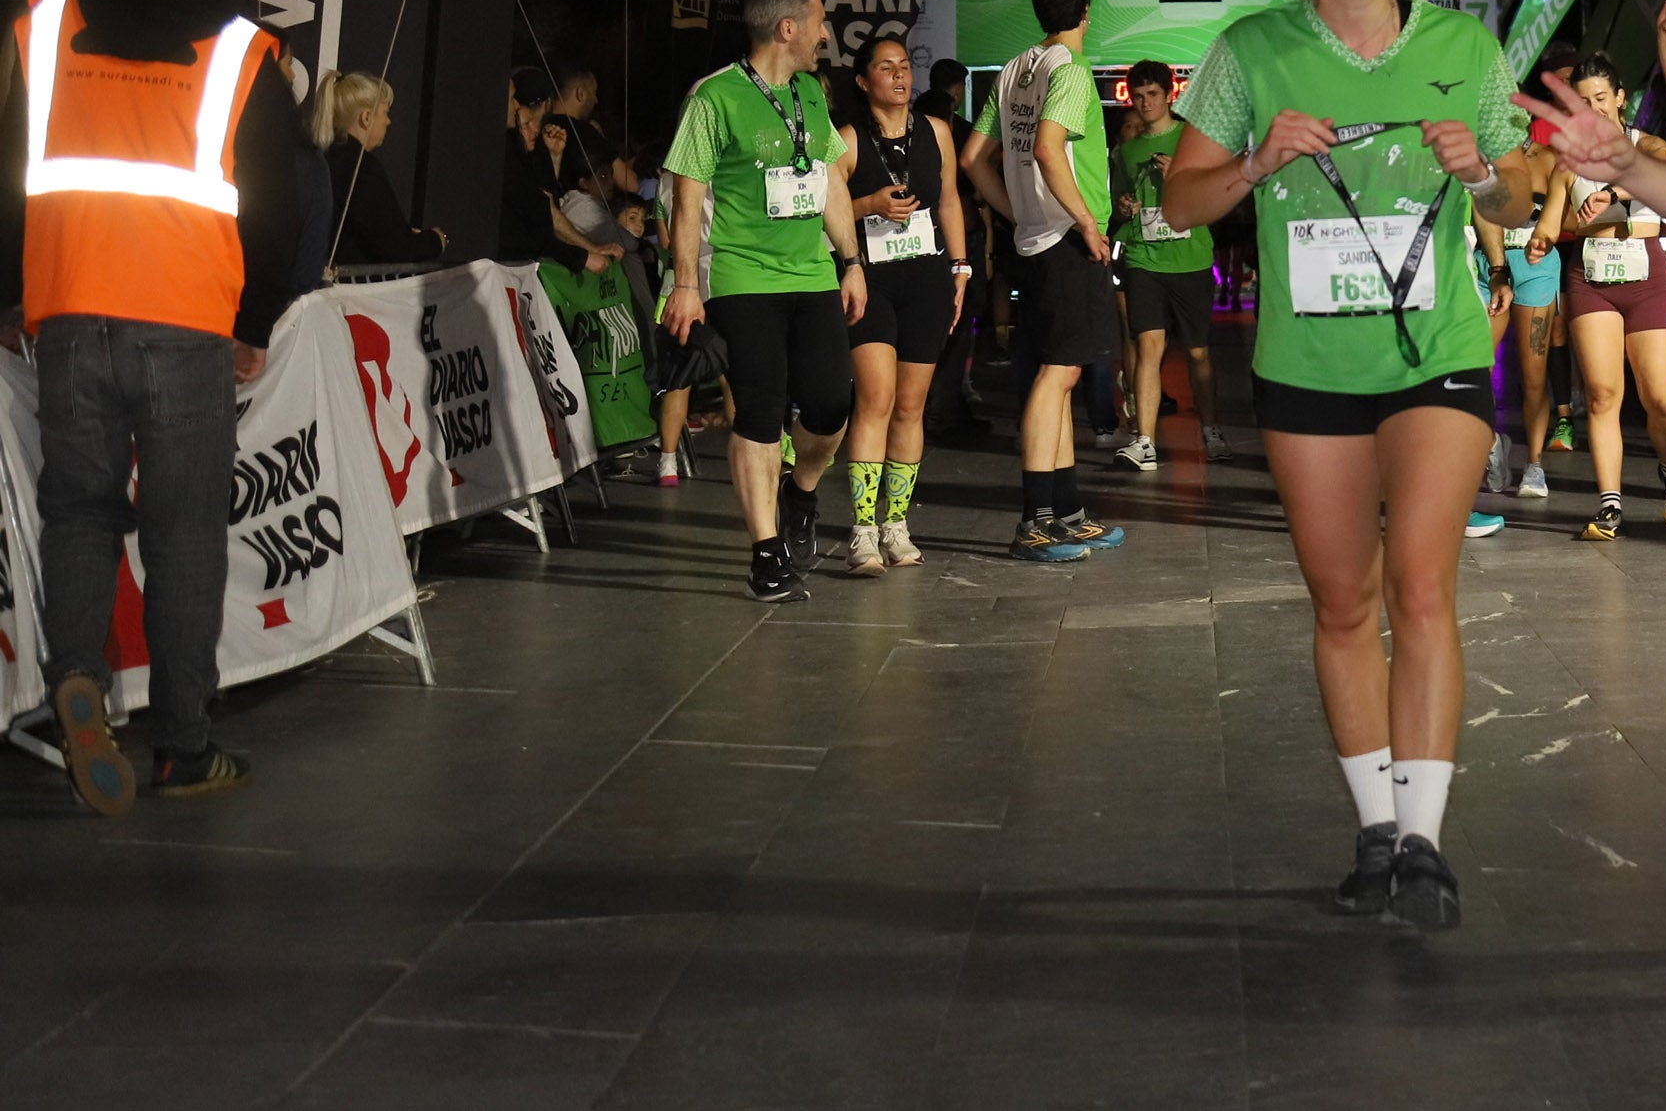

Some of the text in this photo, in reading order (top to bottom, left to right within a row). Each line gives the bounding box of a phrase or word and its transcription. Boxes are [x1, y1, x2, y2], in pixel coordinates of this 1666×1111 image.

[793, 193, 815, 210] 954
[1293, 222, 1315, 240] 10K
[885, 235, 921, 255] F1249
[1604, 263, 1625, 277] F76
[420, 304, 441, 354] EL
[430, 345, 489, 407] DIARIO
[435, 399, 492, 460] VASCO
